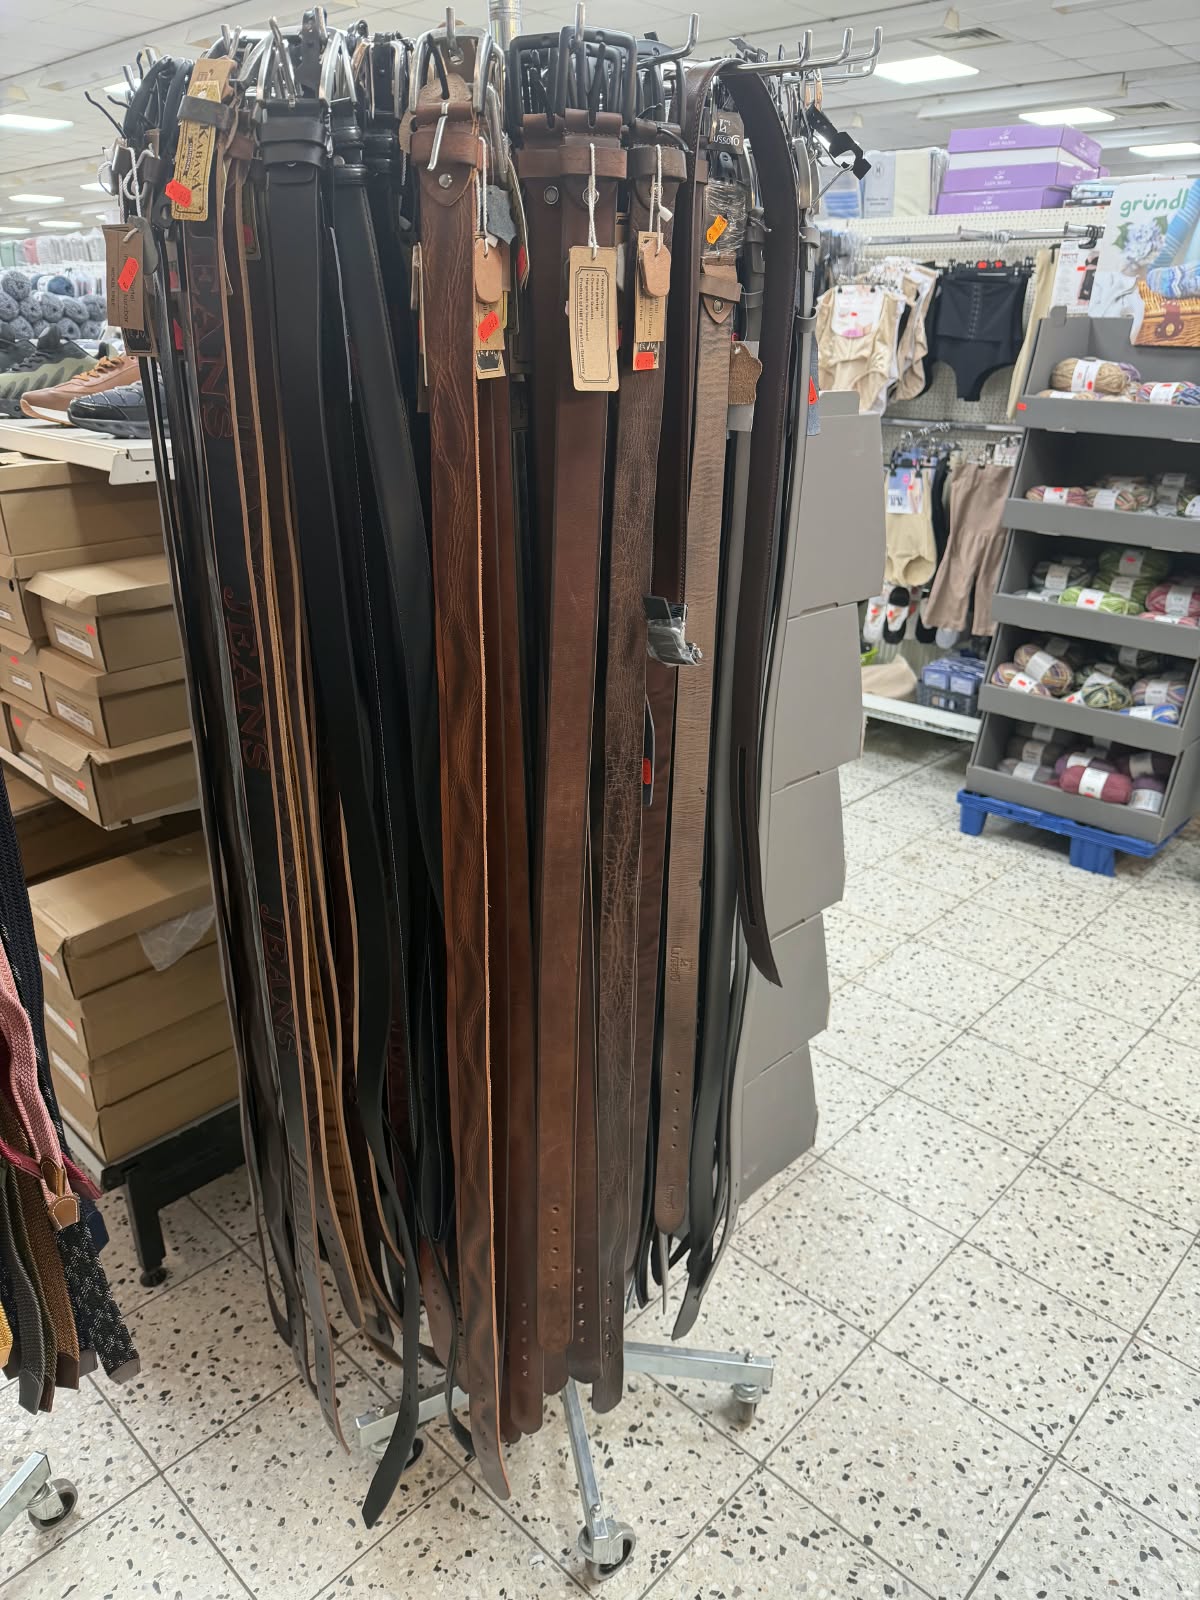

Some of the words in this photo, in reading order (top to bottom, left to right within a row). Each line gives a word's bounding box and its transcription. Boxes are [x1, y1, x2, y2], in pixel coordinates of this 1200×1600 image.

[191, 125, 209, 191] KABANA
[1119, 188, 1190, 218] gründl
[189, 226, 234, 439] JEANS
[223, 586, 270, 771] JEANS
[260, 903, 297, 1052] JEANS
